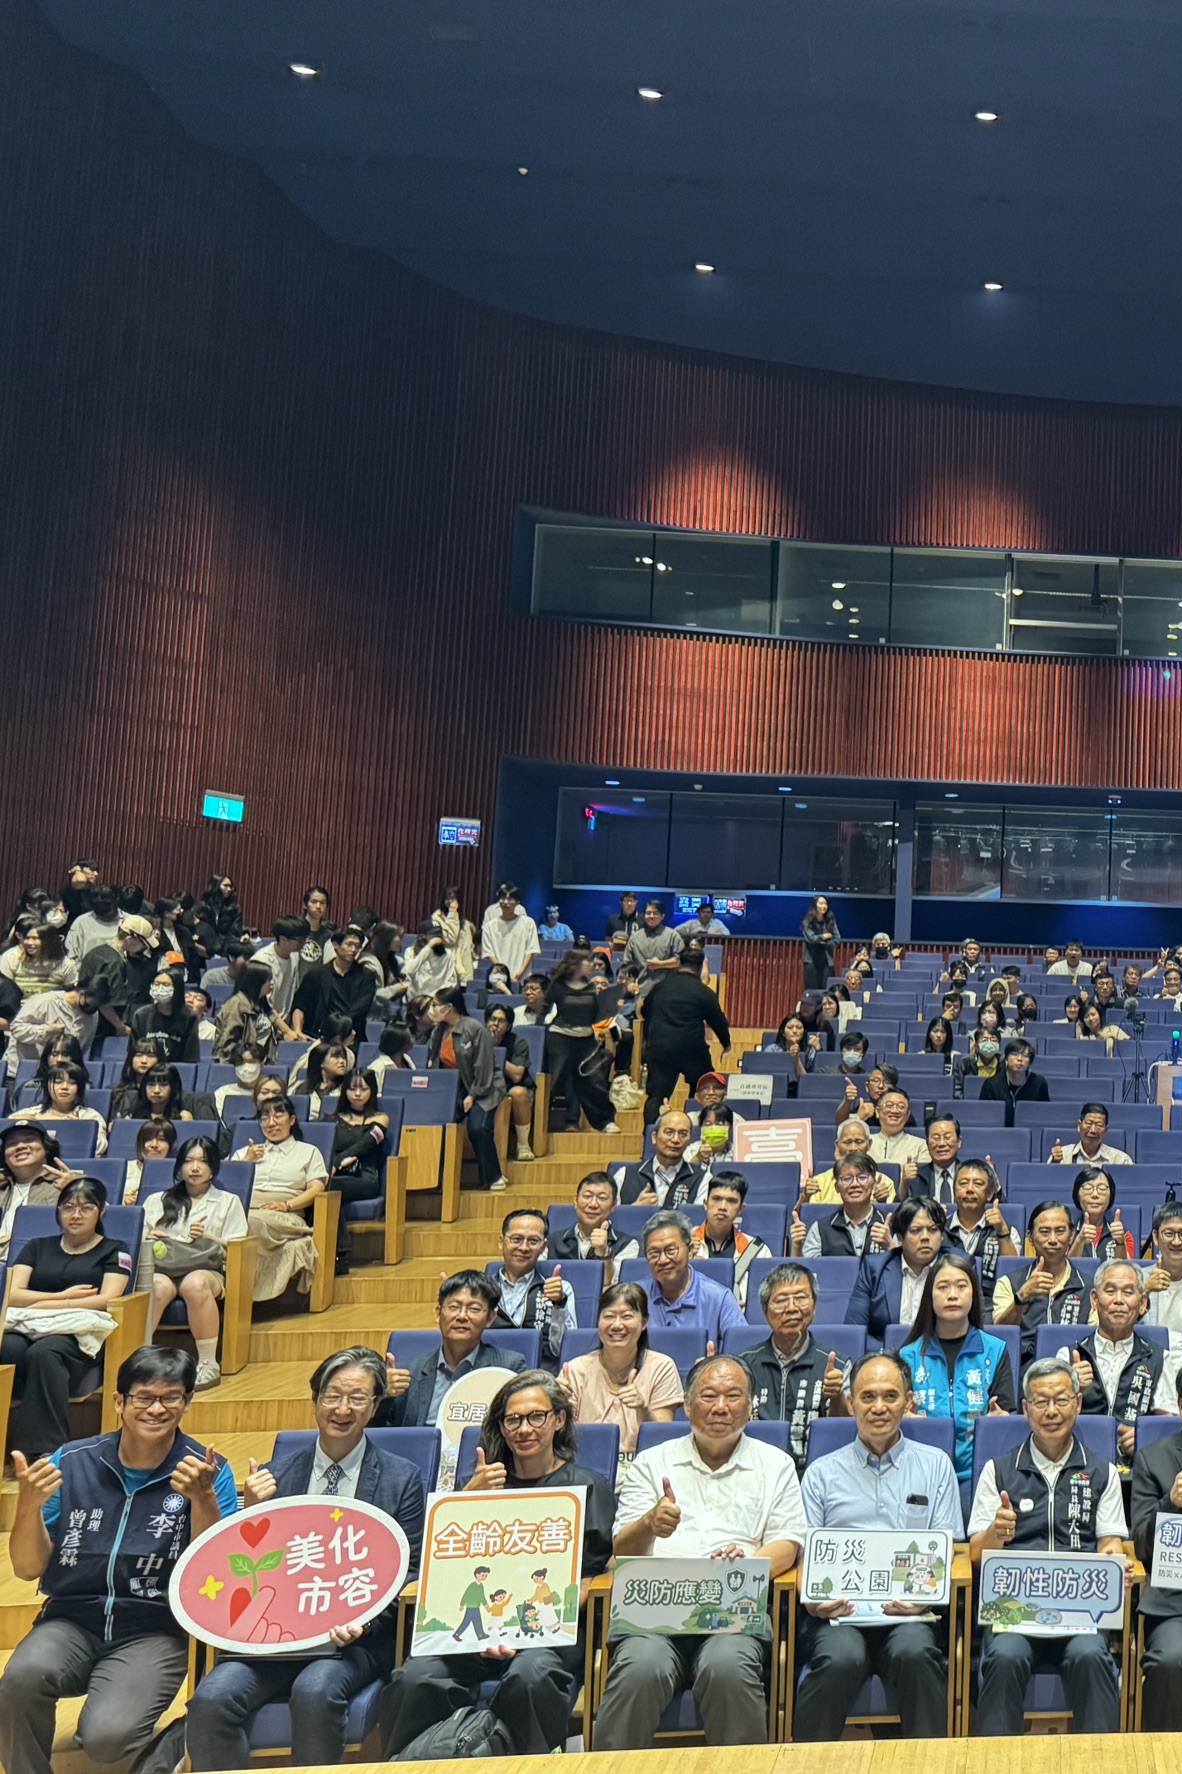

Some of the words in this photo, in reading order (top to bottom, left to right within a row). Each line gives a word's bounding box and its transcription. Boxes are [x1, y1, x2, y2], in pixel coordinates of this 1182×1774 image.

[87, 1508, 104, 1532] 助理
[285, 1525, 369, 1576] 美化
[433, 1517, 574, 1559] 全齡友善
[814, 1538, 865, 1563] 防災
[297, 1567, 379, 1616] 市容
[623, 1578, 723, 1606] 災防應變
[841, 1569, 891, 1594] 公園
[992, 1565, 1109, 1600] 韌性防災
